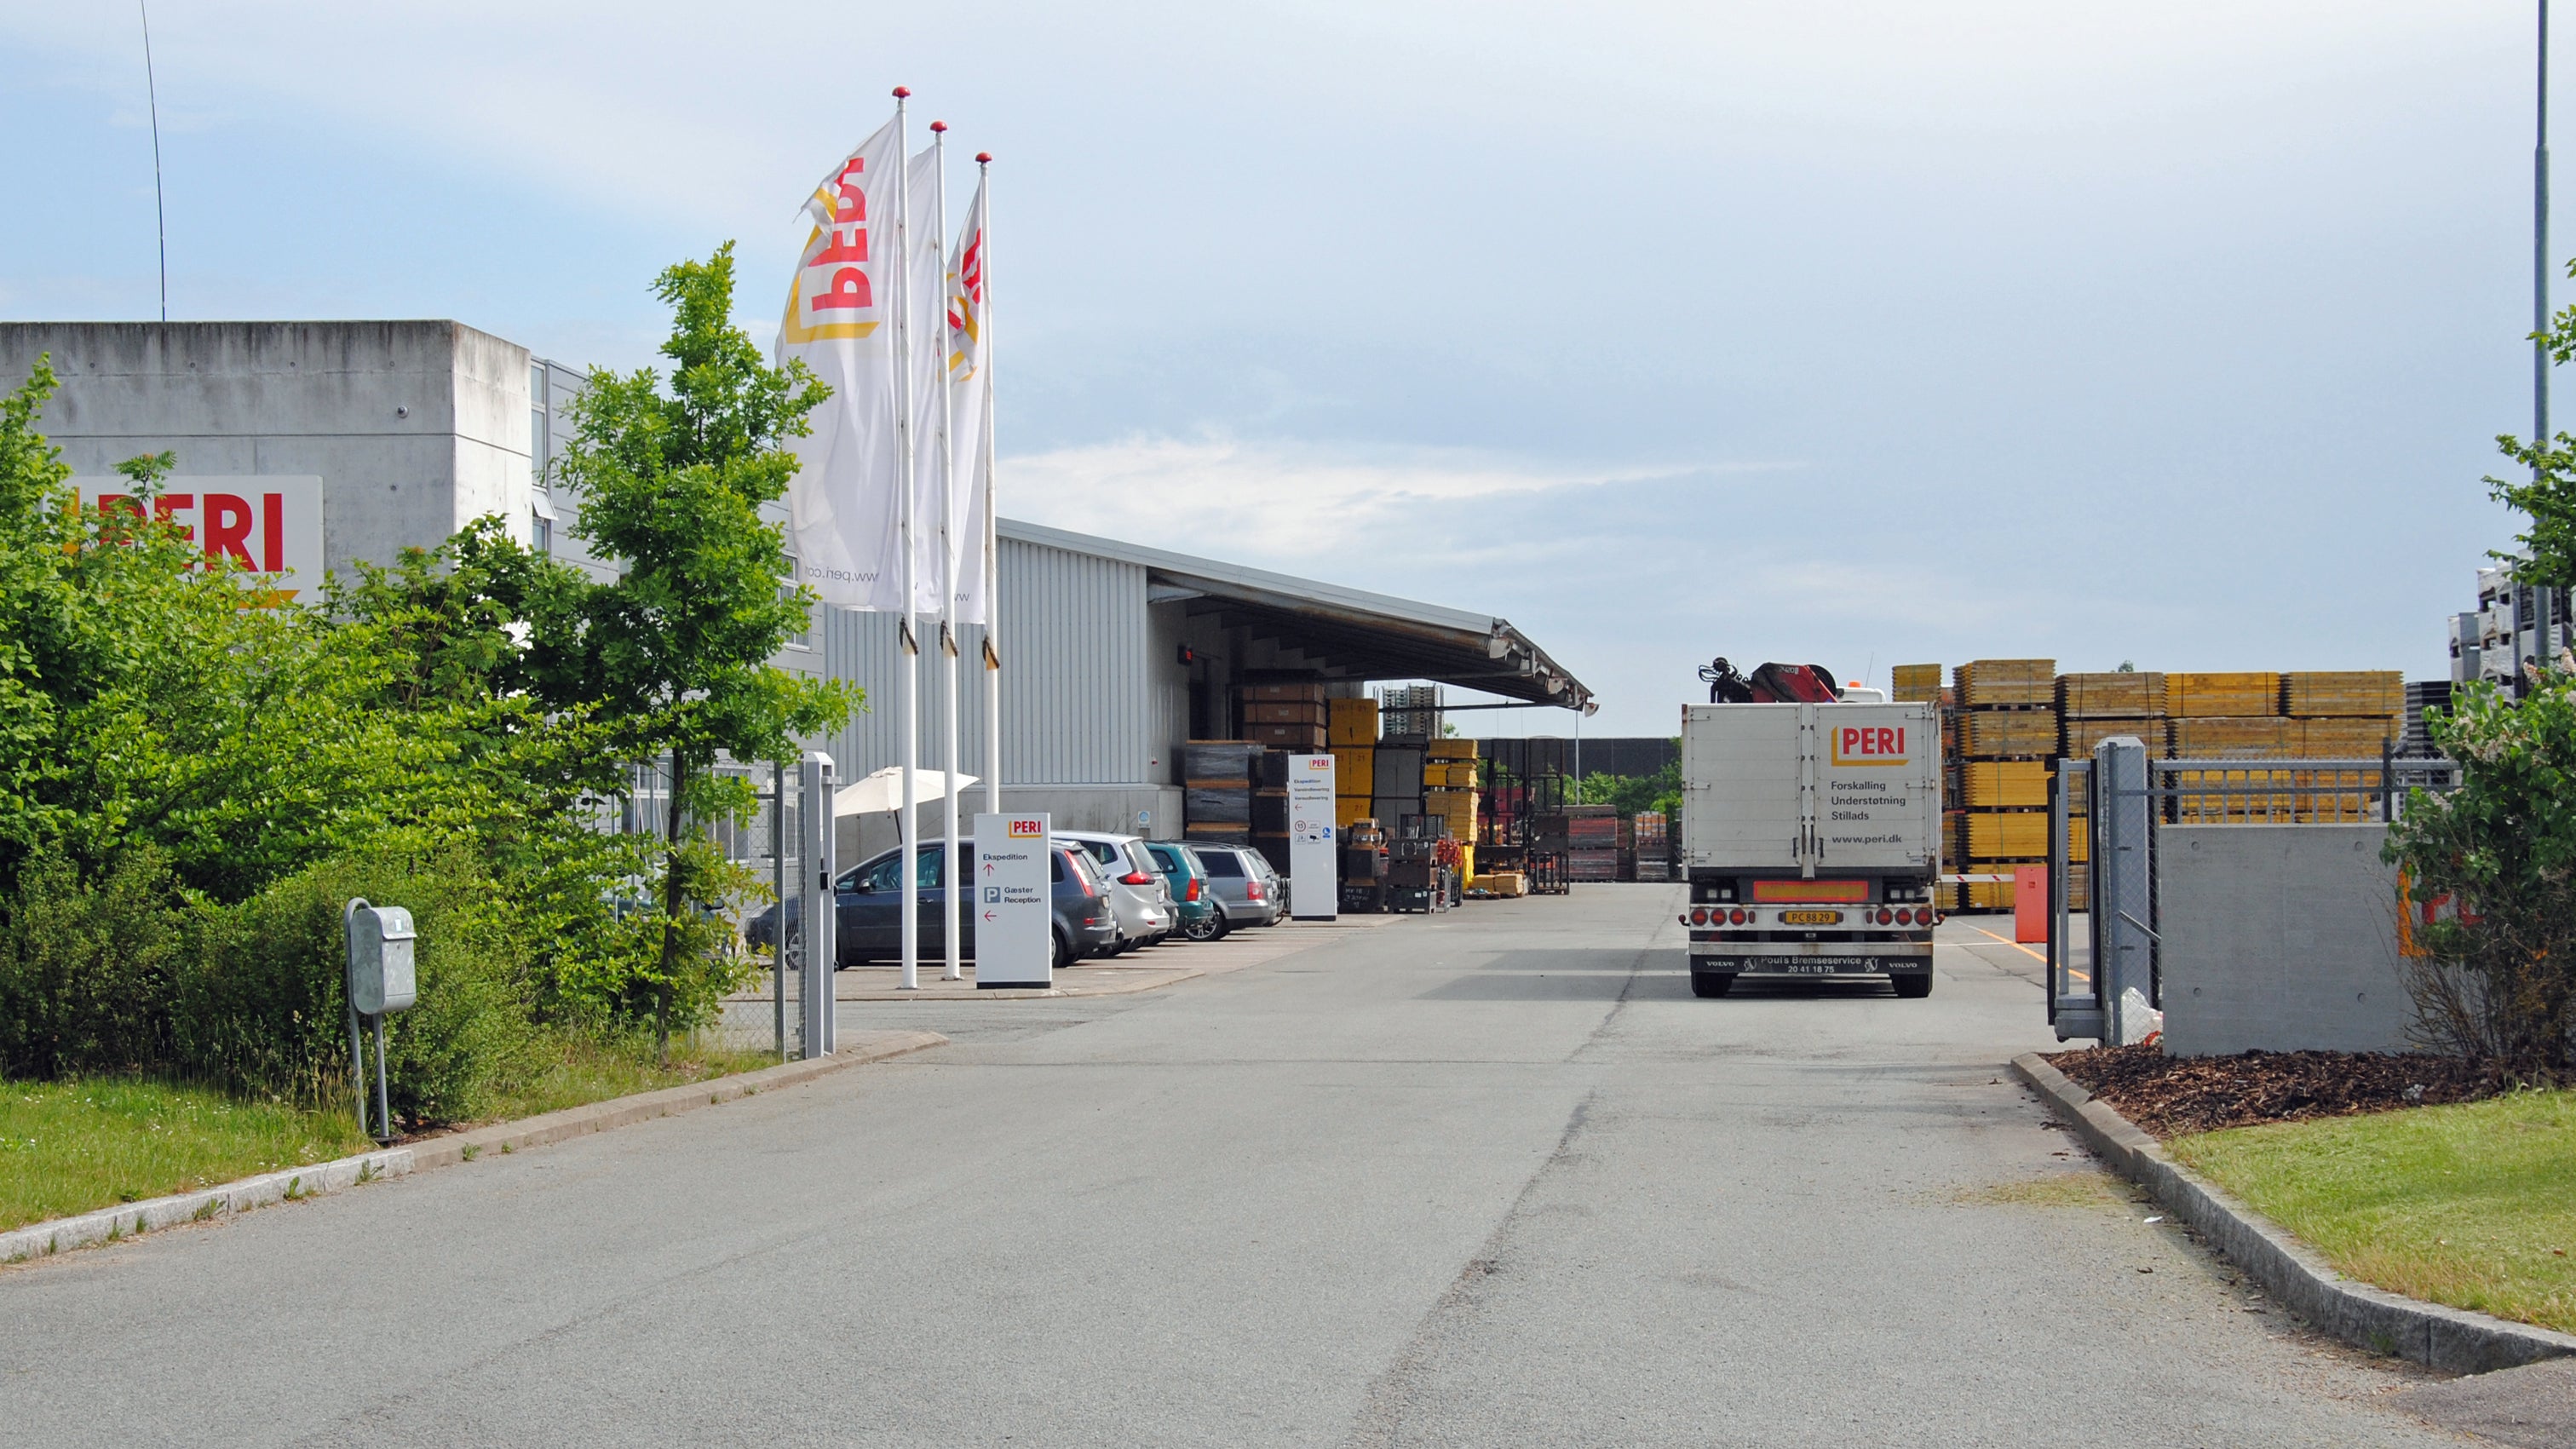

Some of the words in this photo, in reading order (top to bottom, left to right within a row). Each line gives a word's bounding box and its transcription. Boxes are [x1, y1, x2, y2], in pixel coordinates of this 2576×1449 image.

[1843, 727, 1905, 755] PERI
[1312, 759, 1329, 768] PERI
[1831, 780, 1886, 791] Forskalling
[1831, 796, 1906, 807] Understøtning
[1831, 811, 1870, 820] Stillads
[1014, 821, 1041, 833] PERI
[1831, 834, 1902, 845] www.peri.dk
[983, 854, 1028, 862] Ekspedition
[1792, 913, 1804, 922] PC
[1819, 913, 1830, 922] 29
[1791, 956, 1861, 964] Bremseservice
